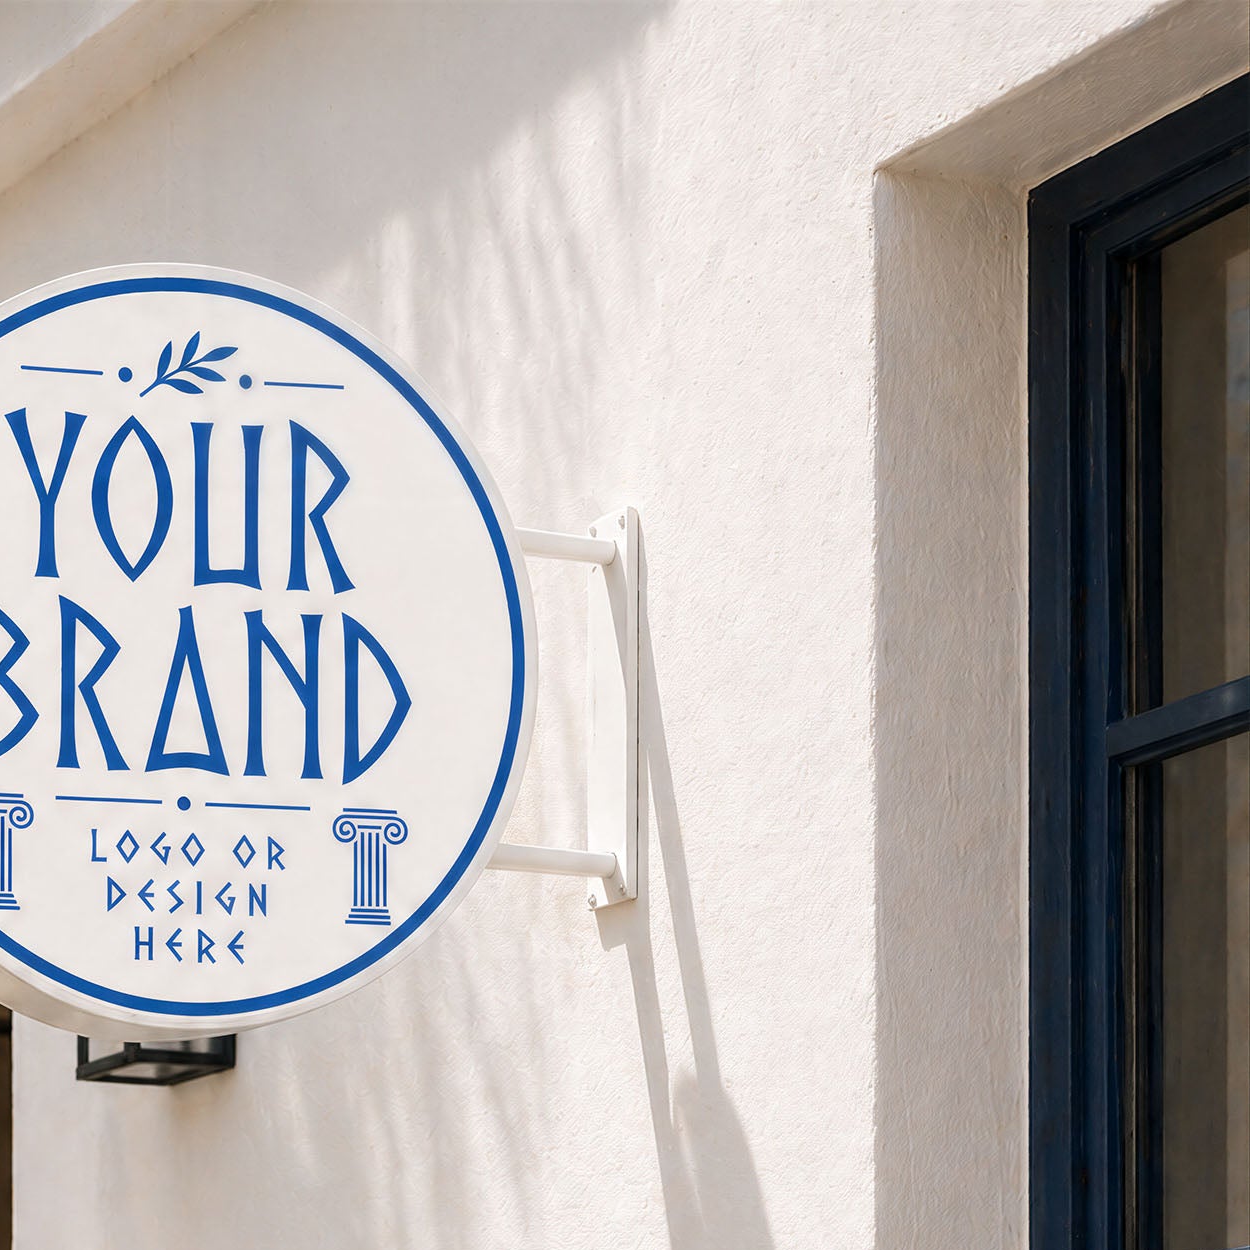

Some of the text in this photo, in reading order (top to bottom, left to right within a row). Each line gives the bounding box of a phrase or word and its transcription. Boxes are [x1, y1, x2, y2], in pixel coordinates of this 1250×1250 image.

[4, 407, 356, 595] YOUR
[90, 827, 287, 871] LOGO OR
[106, 876, 268, 918] DESIGN
[133, 925, 246, 965] HERE
